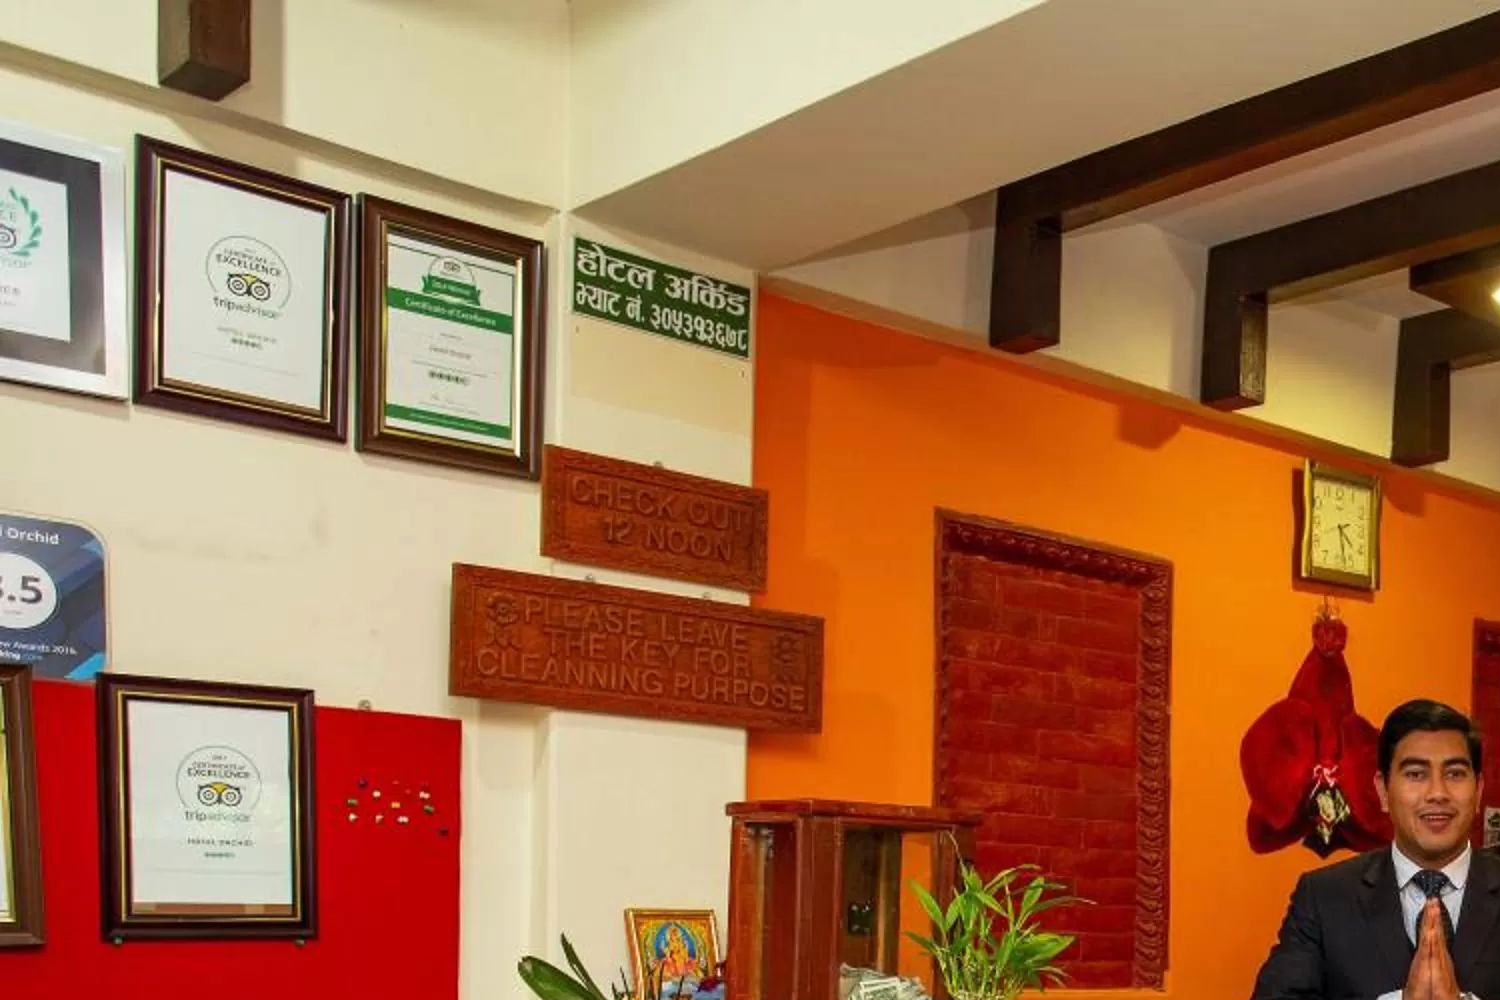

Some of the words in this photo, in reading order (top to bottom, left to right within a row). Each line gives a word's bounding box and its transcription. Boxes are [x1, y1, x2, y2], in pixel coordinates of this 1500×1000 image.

[576, 243, 656, 291] होटल
[571, 476, 677, 521] CHECK
[687, 498, 746, 531] OUT
[7, 527, 59, 545] Orchid
[605, 518, 633, 547] 12
[645, 521, 734, 561] NOON
[523, 595, 650, 637] PLEASE
[660, 614, 749, 650] LEAVE
[545, 628, 608, 660] THE
[621, 637, 680, 668] KEY
[693, 647, 753, 678] FOR
[476, 647, 663, 696] CLEANNING
[674, 673, 806, 712] PURPOSE
